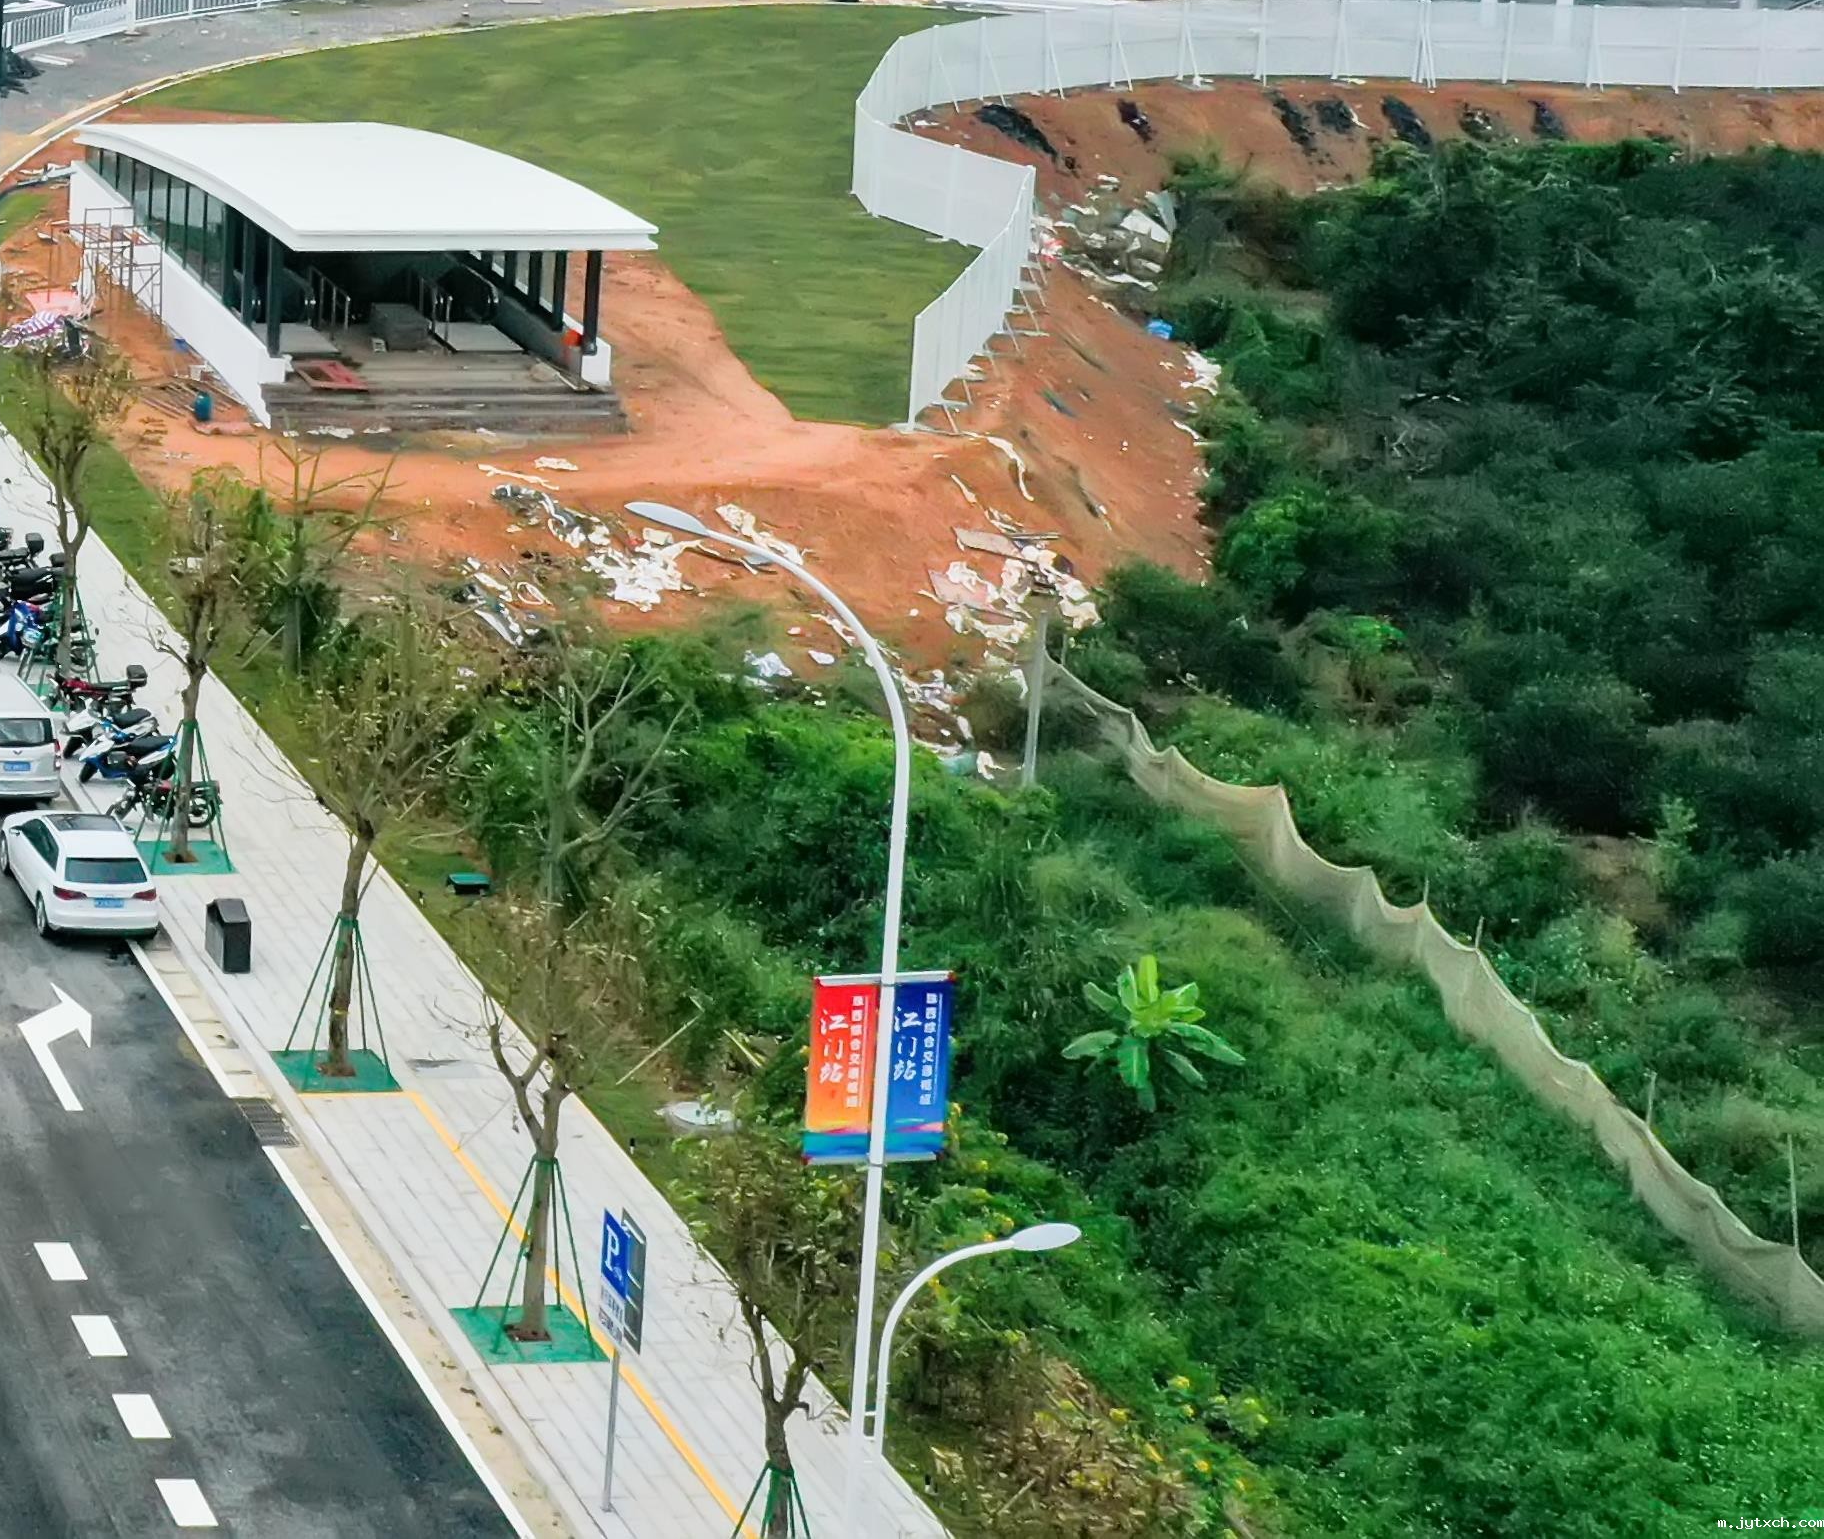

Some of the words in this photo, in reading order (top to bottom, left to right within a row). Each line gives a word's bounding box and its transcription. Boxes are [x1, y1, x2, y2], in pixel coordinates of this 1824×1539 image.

[818, 1008, 850, 1084] 江门站
[892, 1006, 923, 1082] 江门站
[605, 1223, 620, 1272] P
